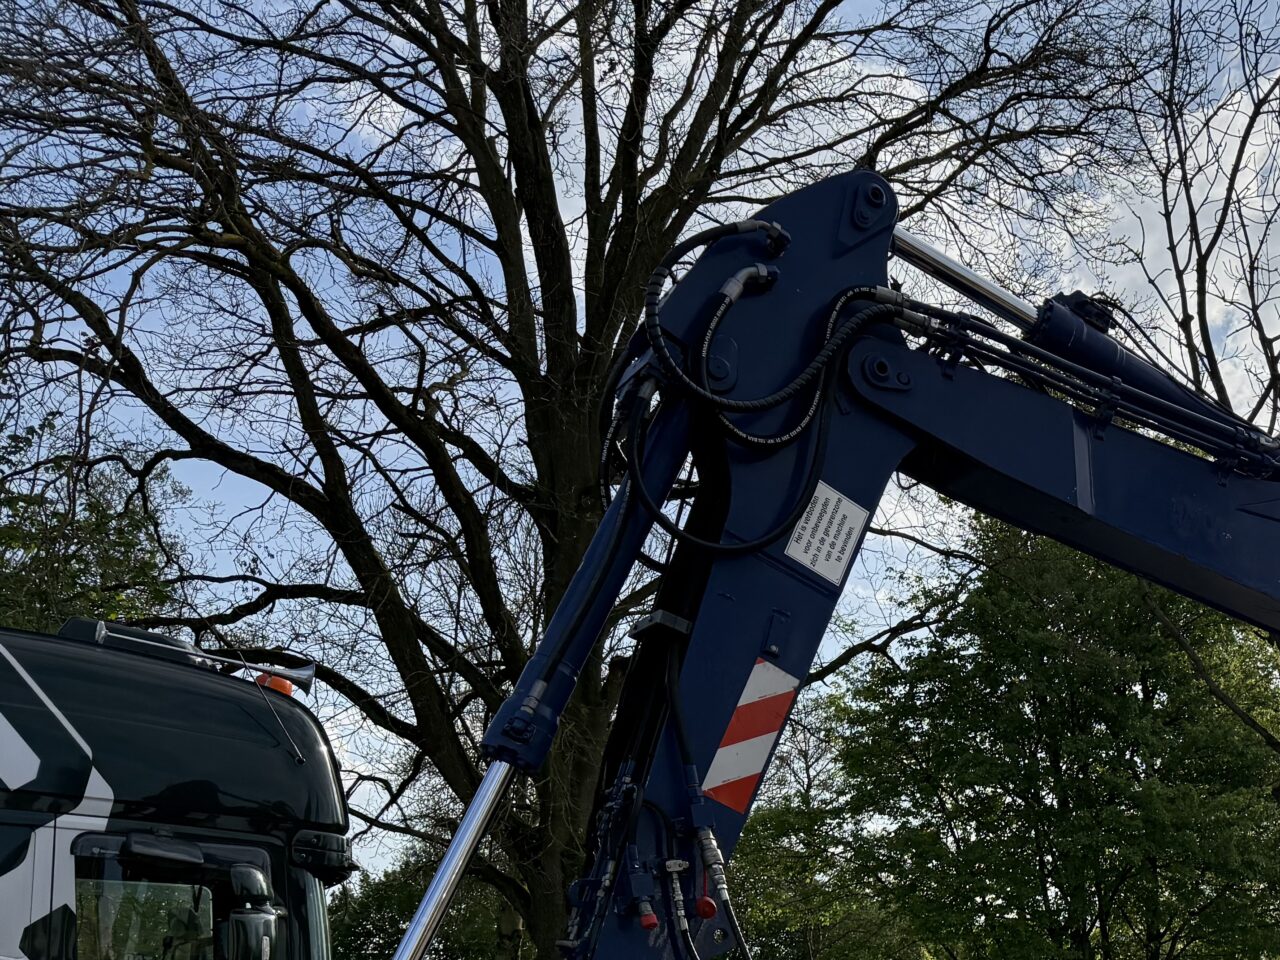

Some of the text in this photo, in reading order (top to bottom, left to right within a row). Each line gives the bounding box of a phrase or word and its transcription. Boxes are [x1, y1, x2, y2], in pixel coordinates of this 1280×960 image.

[794, 533, 805, 544] Het
[804, 496, 820, 525] verboden
[803, 497, 831, 554] voor onbevoegden
[810, 497, 843, 567] zich in de gevarenzone
[824, 513, 848, 562] van de machine
[835, 526, 854, 563] te bevinden.
